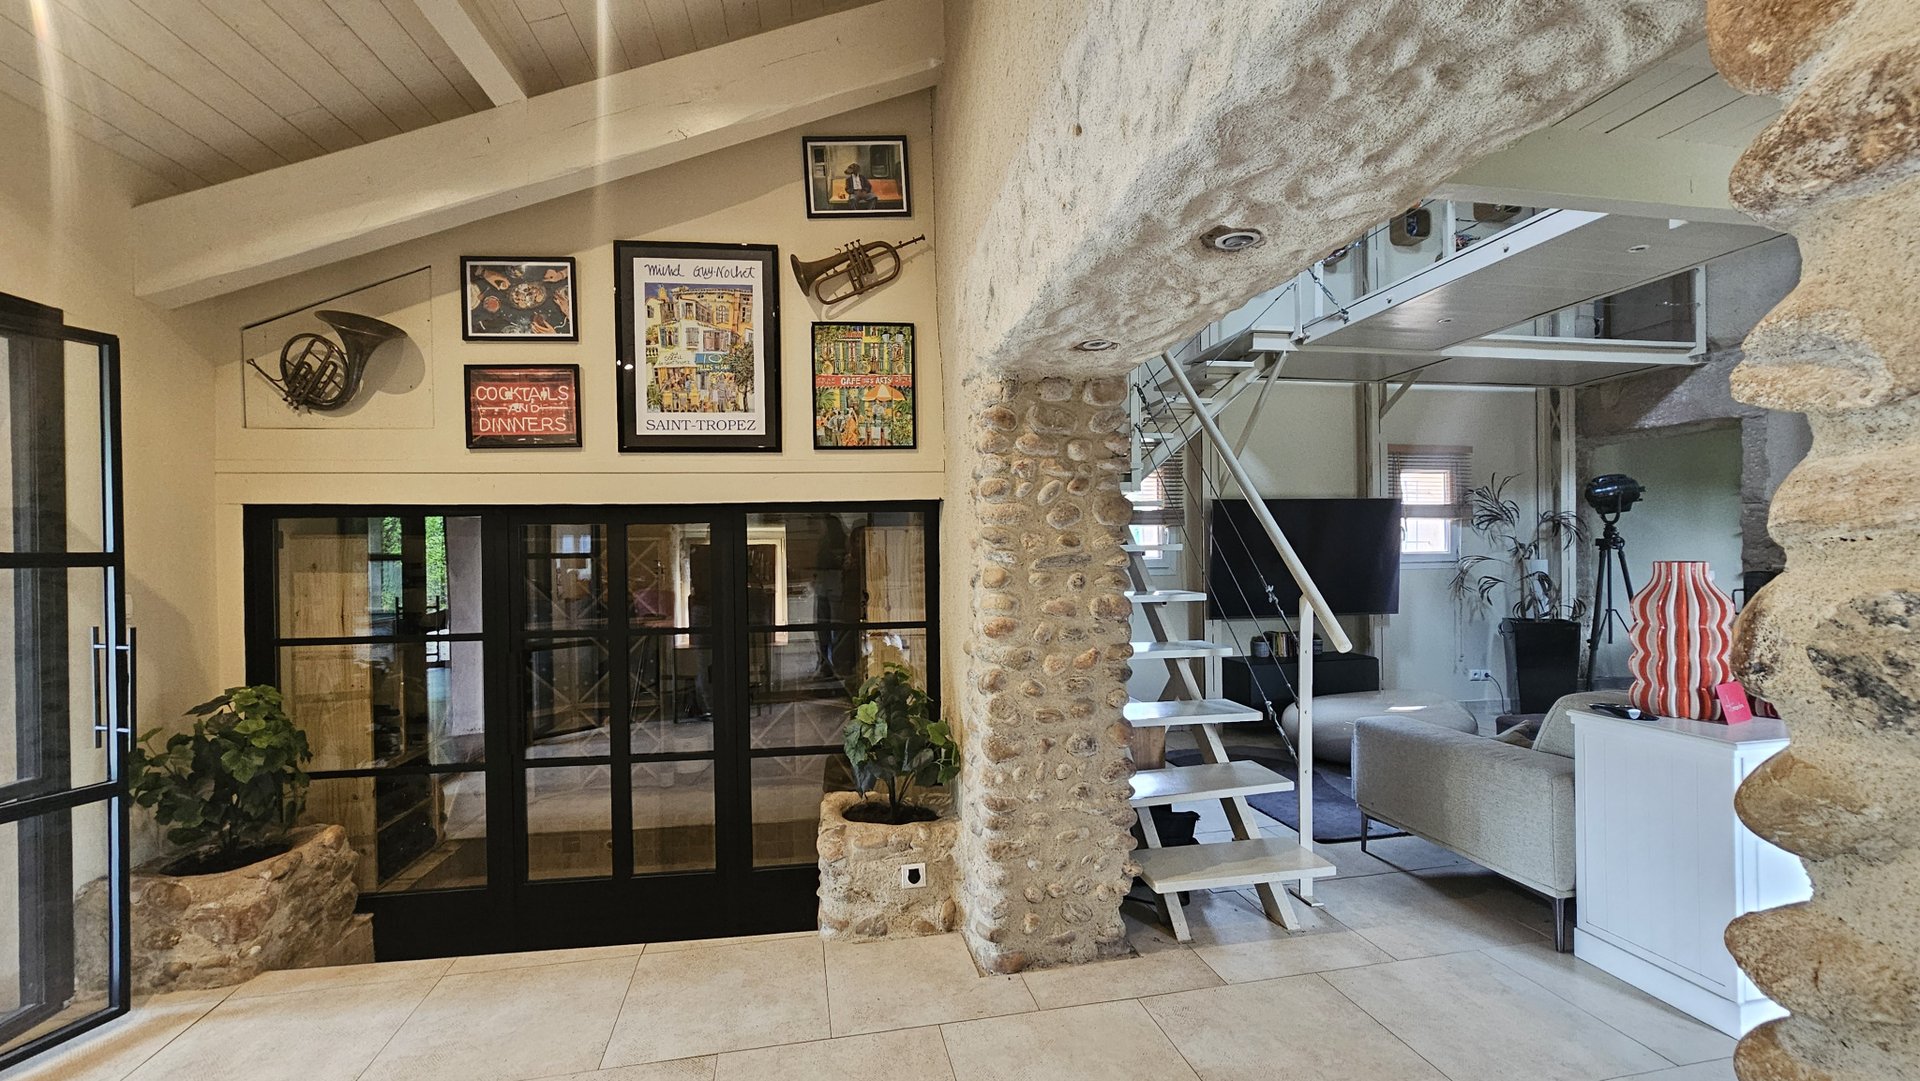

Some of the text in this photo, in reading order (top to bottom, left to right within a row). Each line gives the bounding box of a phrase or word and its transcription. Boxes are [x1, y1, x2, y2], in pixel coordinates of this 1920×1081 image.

[476, 386, 569, 401] COCKTAILS
[507, 404, 541, 413] AND
[479, 417, 567, 432] DINNERS
[646, 419, 757, 431] SAINT-TROPEZ
